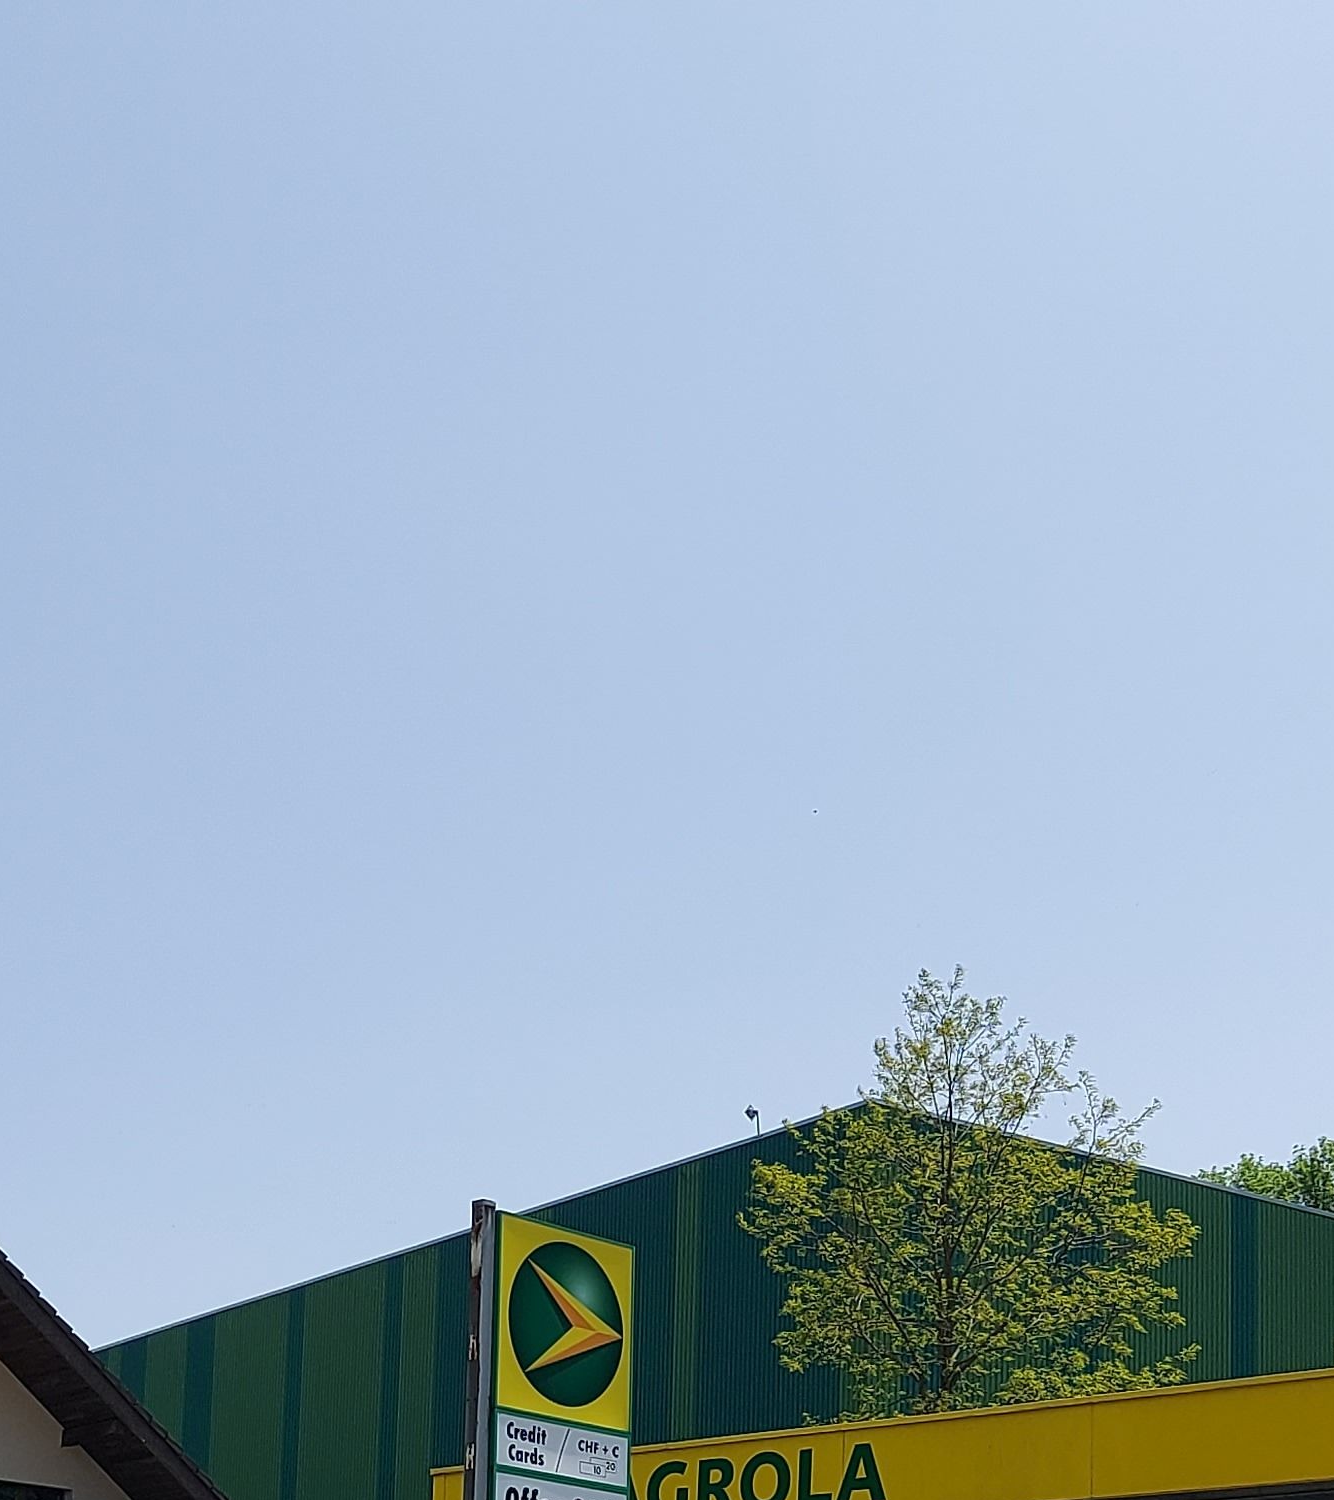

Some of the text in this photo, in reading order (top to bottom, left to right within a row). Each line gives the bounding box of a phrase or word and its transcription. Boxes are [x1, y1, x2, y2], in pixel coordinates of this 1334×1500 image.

[506, 1422, 547, 1445] Credit
[578, 1439, 599, 1454] CHF
[508, 1444, 545, 1466] Cards
[593, 1465, 602, 1475] 10
[606, 1461, 616, 1471] 20
